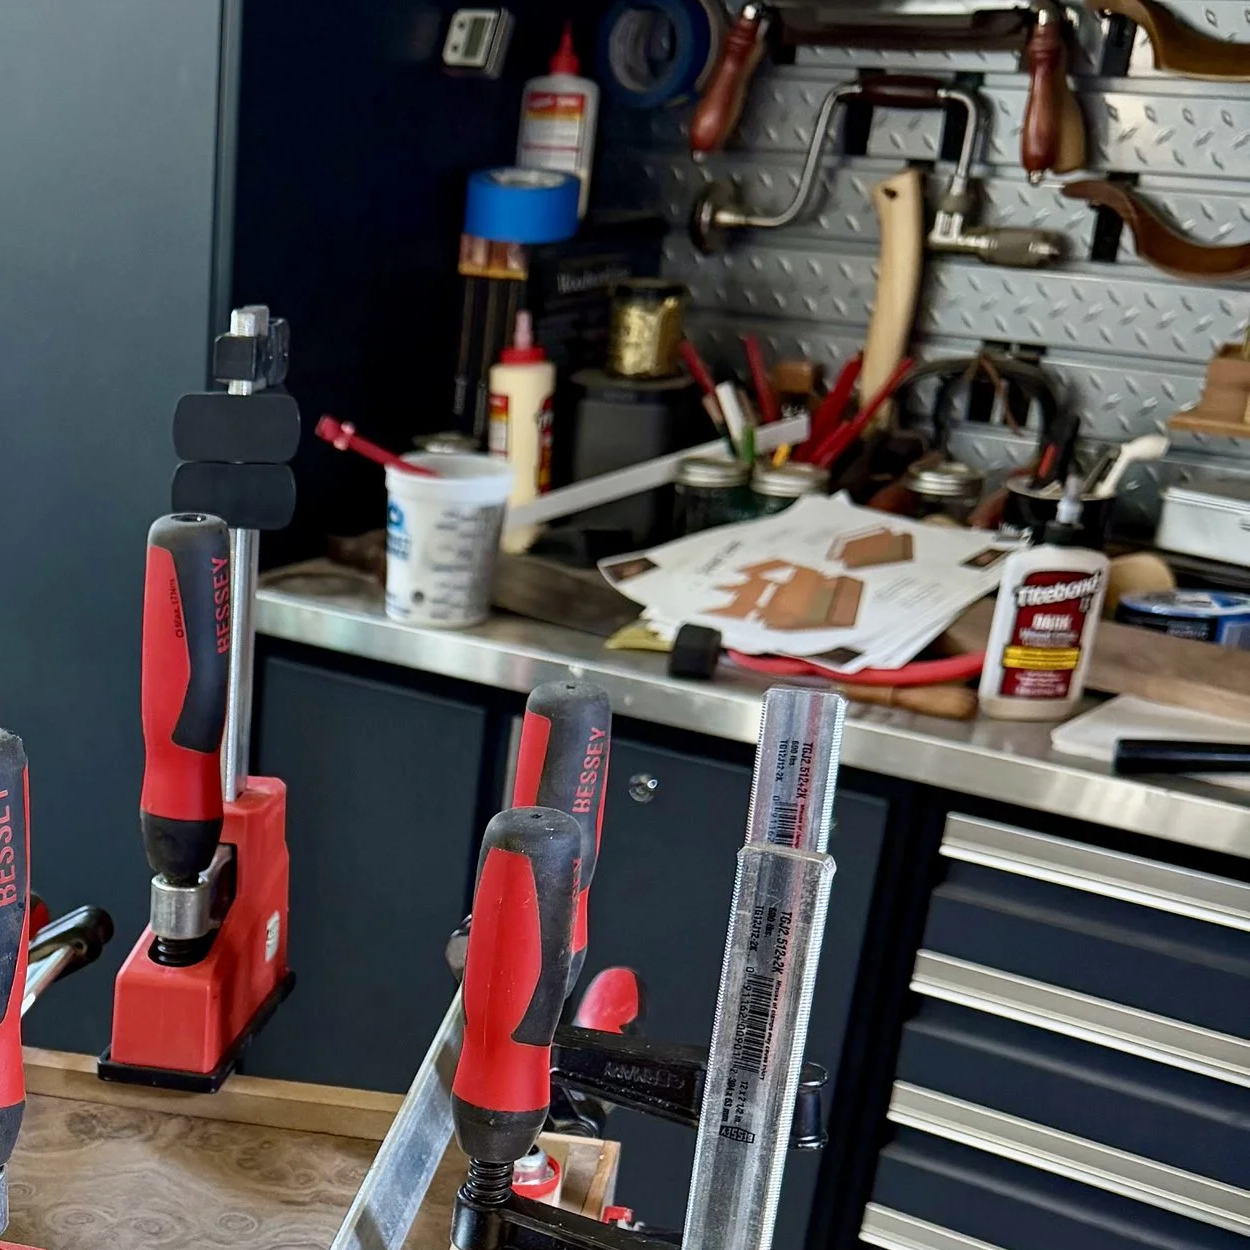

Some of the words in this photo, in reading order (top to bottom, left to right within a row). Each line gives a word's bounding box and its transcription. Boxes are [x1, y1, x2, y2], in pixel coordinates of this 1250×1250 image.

[211, 557, 230, 654] BESSEY
[572, 727, 607, 814] BESSEY
[796, 742, 813, 799] TGJ2.512+2K
[749, 905, 765, 952] TG12J12-2K
[771, 911, 793, 975] TGJ2.512+2K
[745, 966, 755, 974] 0
[738, 984, 751, 1018] 91162
[772, 1002, 778, 1010] of
[773, 980, 782, 1001] Misuse
[733, 1024, 745, 1057] 00901
[719, 1125, 756, 1144] BESSEY
